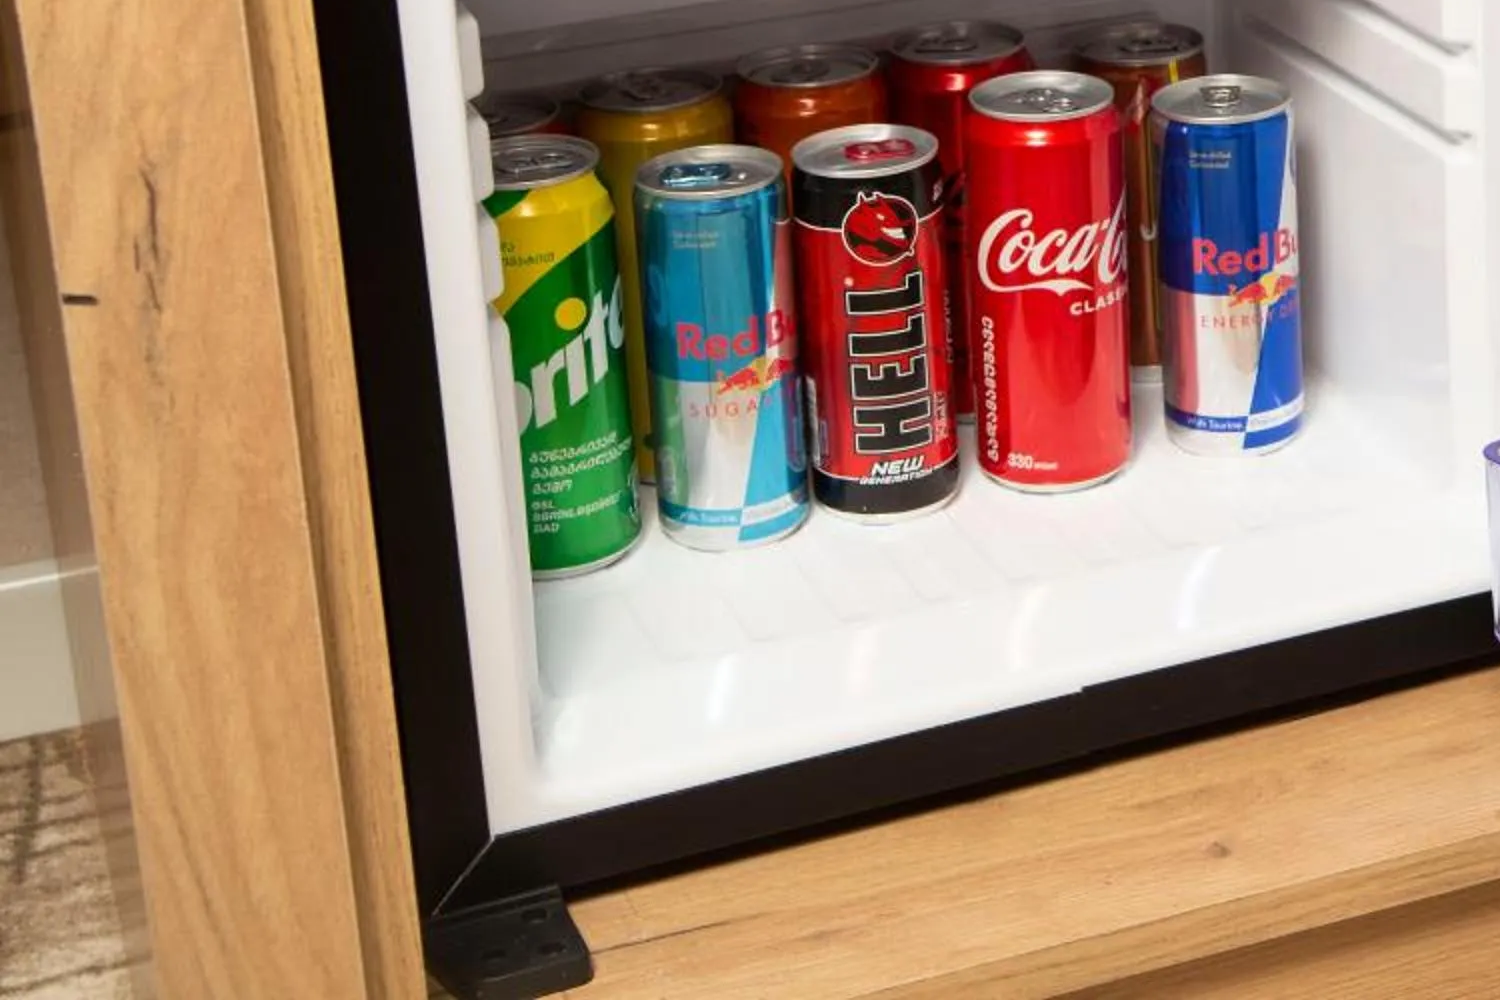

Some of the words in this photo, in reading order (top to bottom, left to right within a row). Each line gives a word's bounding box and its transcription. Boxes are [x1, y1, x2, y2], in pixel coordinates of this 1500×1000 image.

[1192, 231, 1269, 276] Red
[675, 315, 761, 362] Red
[844, 270, 933, 456] HELL
[871, 455, 925, 476] NEW
[1007, 452, 1033, 470] 330
